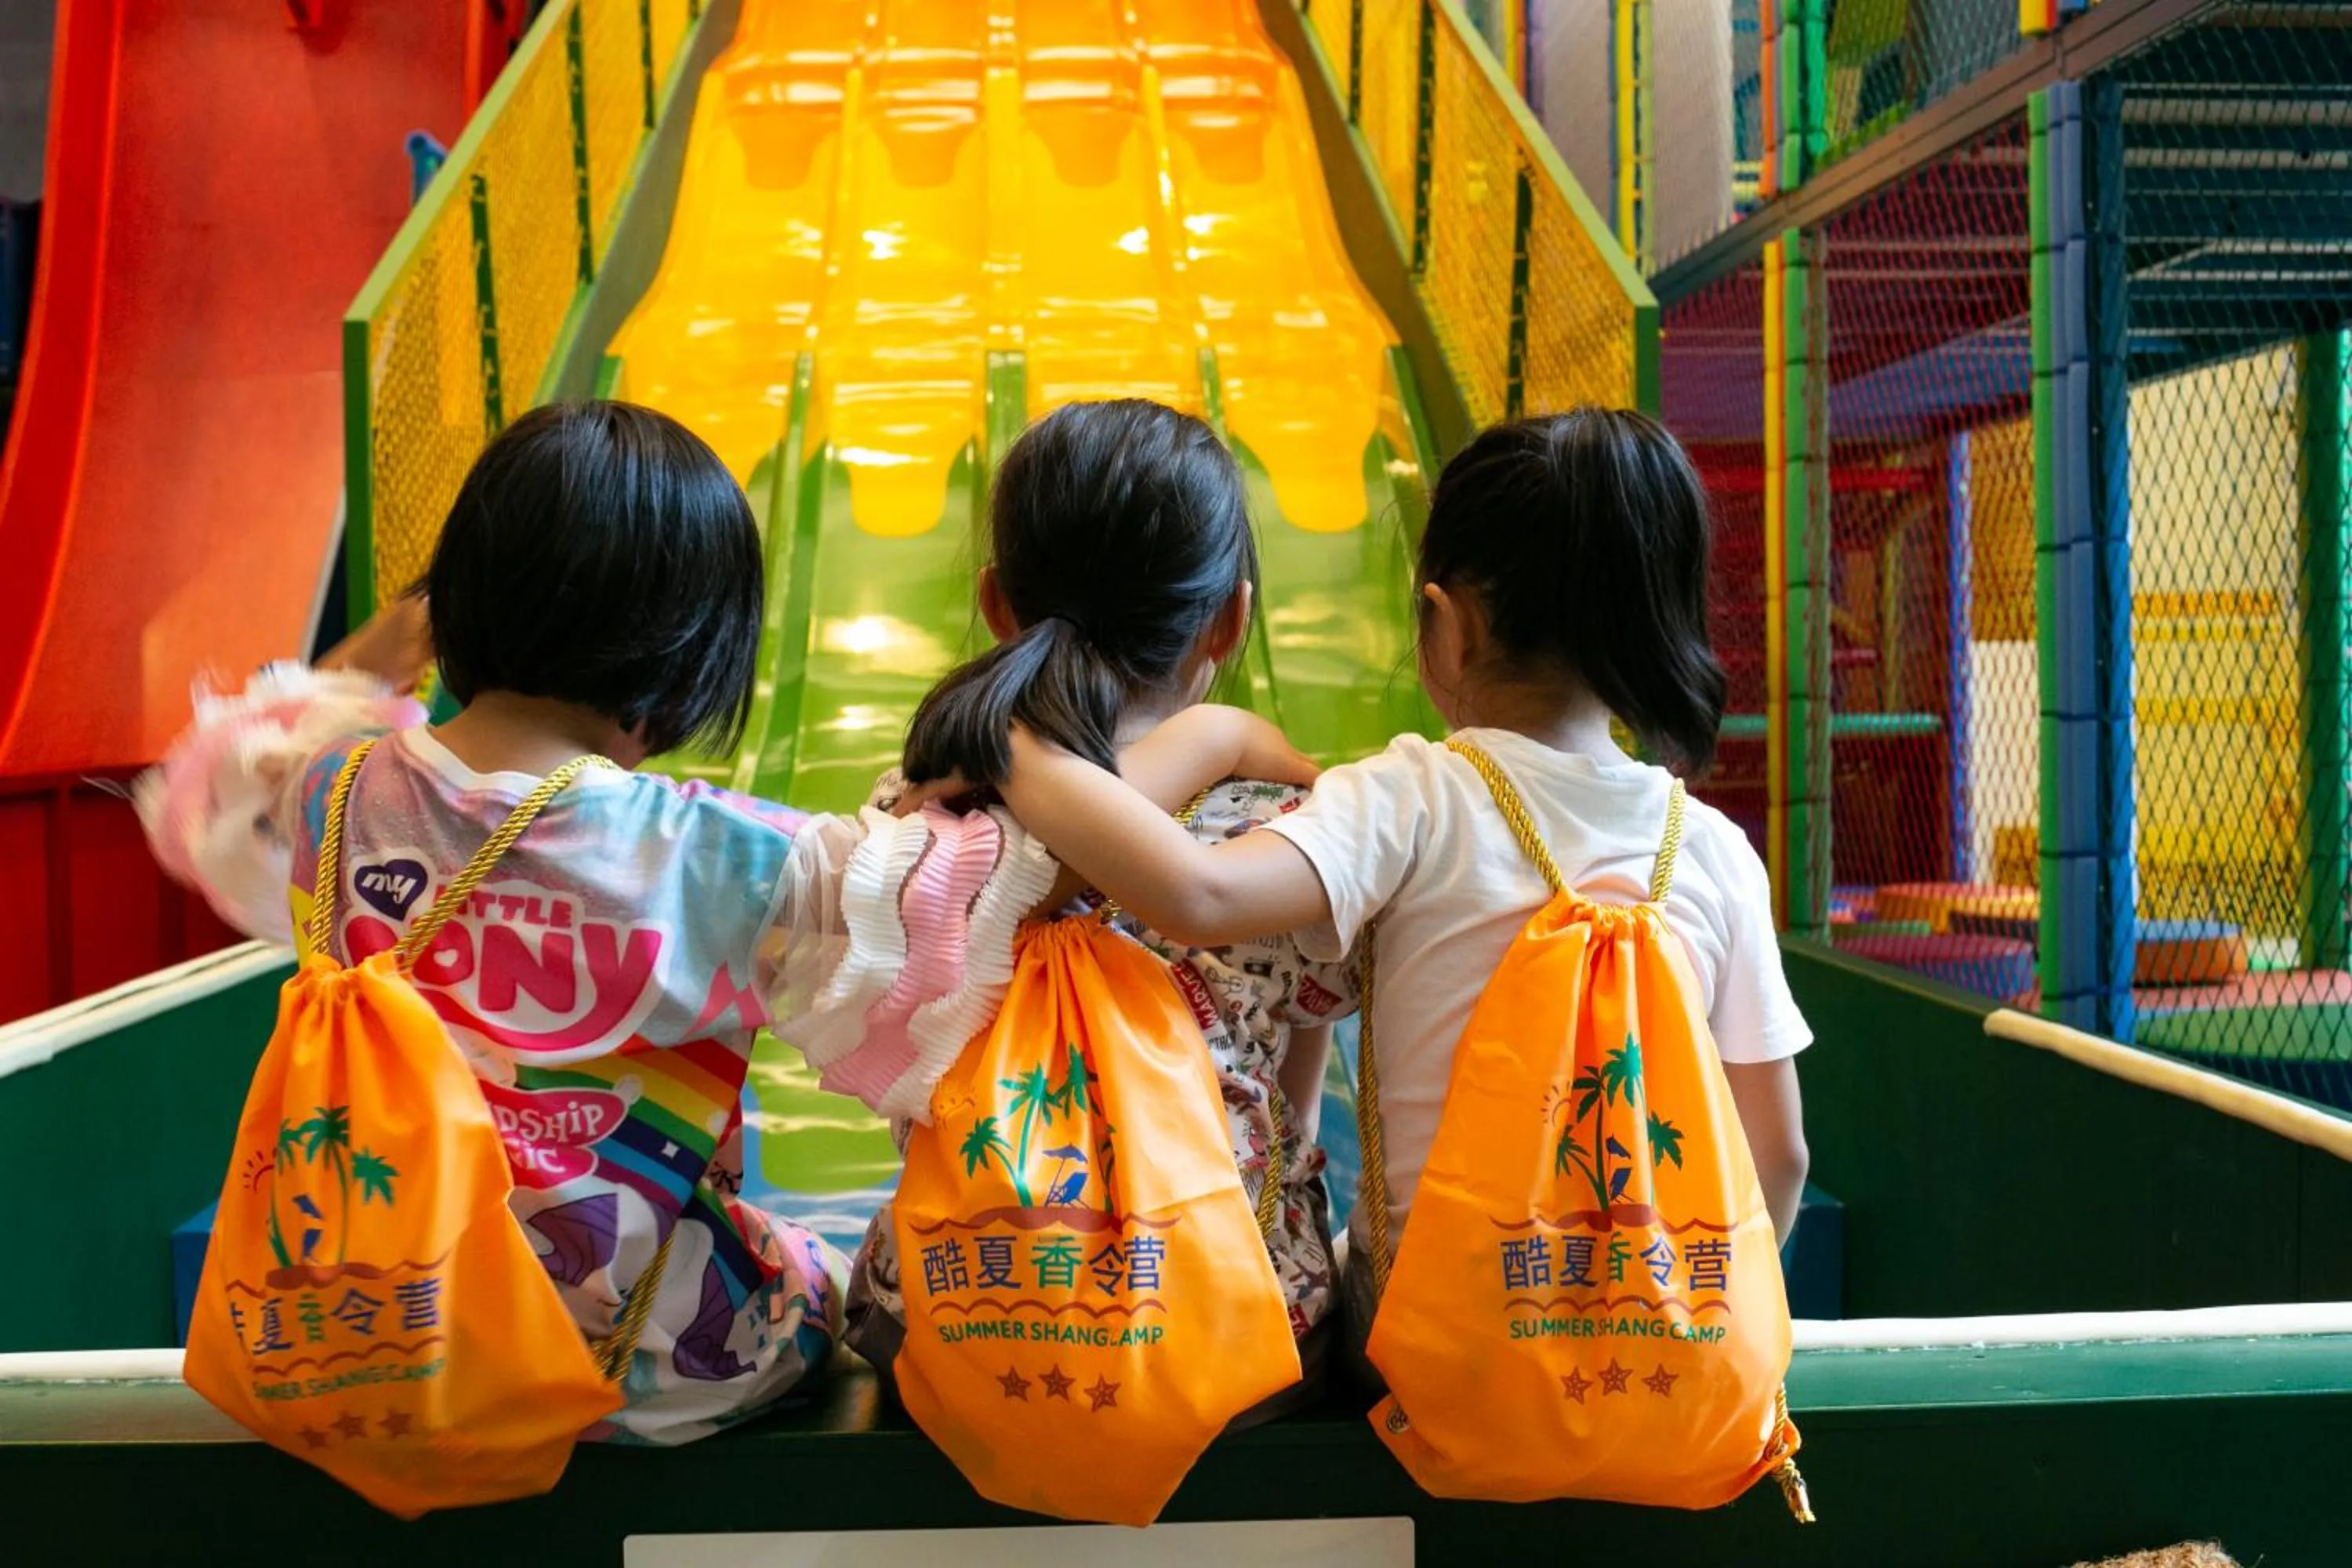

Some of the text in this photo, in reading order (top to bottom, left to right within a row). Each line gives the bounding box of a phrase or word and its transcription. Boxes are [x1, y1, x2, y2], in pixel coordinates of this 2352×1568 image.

[434, 884, 572, 928] TTLE
[921, 1235, 1166, 1298] 酷夏香令营
[1498, 1231, 1732, 1292] 酷夏香令营
[230, 1277, 441, 1356] 夏香令营
[938, 1319, 1164, 1348] SUMMER SHANG AMP
[1509, 1317, 1596, 1340] SUMMER
[1668, 1322, 1726, 1345] CAMP
